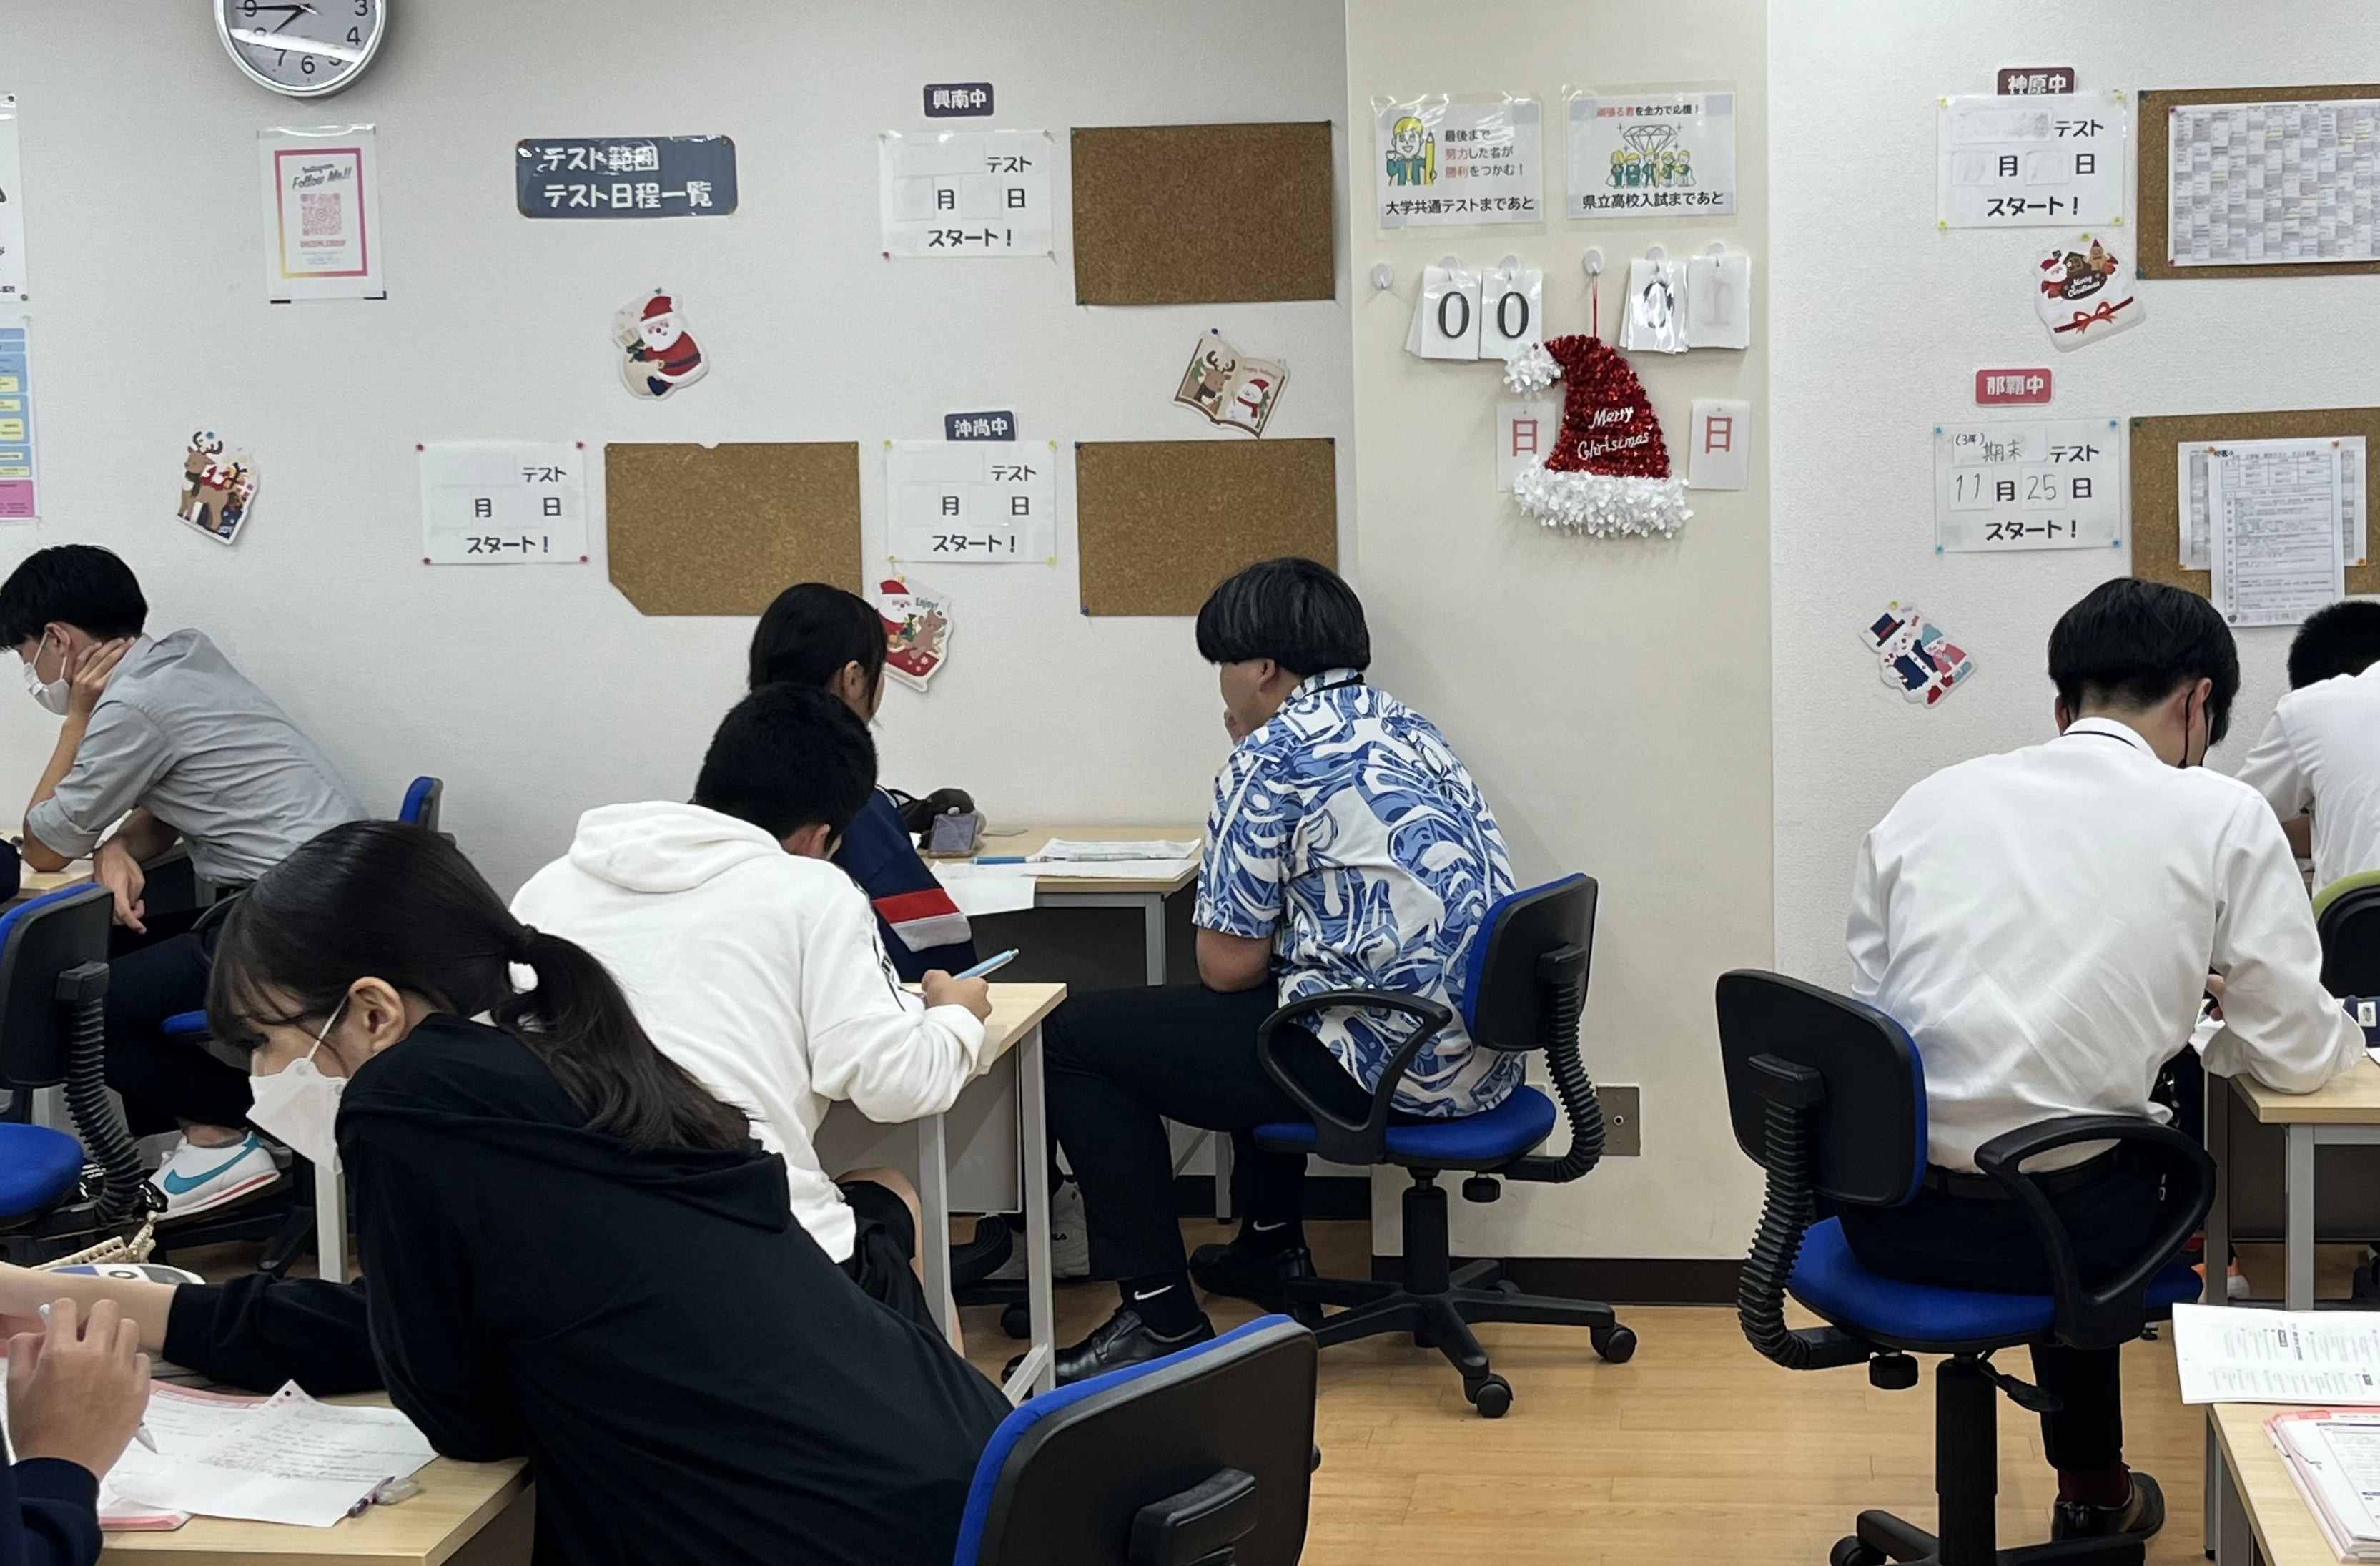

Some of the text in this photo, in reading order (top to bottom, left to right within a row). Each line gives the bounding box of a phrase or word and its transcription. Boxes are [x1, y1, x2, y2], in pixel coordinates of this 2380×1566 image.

[346, 26, 361, 46] 4
[274, 49, 287, 66] 7
[301, 55, 315, 74] 6
[2008, 74, 2066, 94] 神原中
[933, 89, 987, 109] 興南中
[1445, 129, 1491, 142] 最後まで
[2054, 119, 2104, 137] テスト
[543, 145, 659, 172] テスト範囲
[1445, 146, 1514, 160] 努力した者が
[987, 156, 1032, 173] テスト
[1445, 164, 1524, 179] 勝利をつかむ！
[1999, 154, 2095, 177] 月 日
[544, 180, 713, 209] テスト日程一覧
[938, 188, 1025, 210] 月 日
[1583, 191, 1724, 210] 県立高校入試まであと
[1386, 196, 1535, 215] 大学共通テストまであと
[1987, 196, 2079, 217] スタート！
[928, 228, 1012, 247] スタート！
[1438, 291, 1529, 338] 0 0
[1986, 375, 2044, 395] 那覇中
[954, 417, 1009, 438] 沖尚中
[1588, 406, 1634, 429] Merry
[1705, 415, 1733, 454] 日
[1577, 431, 1649, 461] Christmas
[1982, 439, 2099, 463] 期末 テスト
[522, 466, 567, 483] テスト
[991, 465, 1037, 481] テスト
[1956, 473, 2092, 502] 11 月 25 日
[475, 497, 561, 518] 月 日
[942, 496, 1029, 516] 月 日
[1985, 520, 2076, 541] スタート！
[466, 536, 548, 553] スタート！
[932, 534, 1015, 553] スタート！
